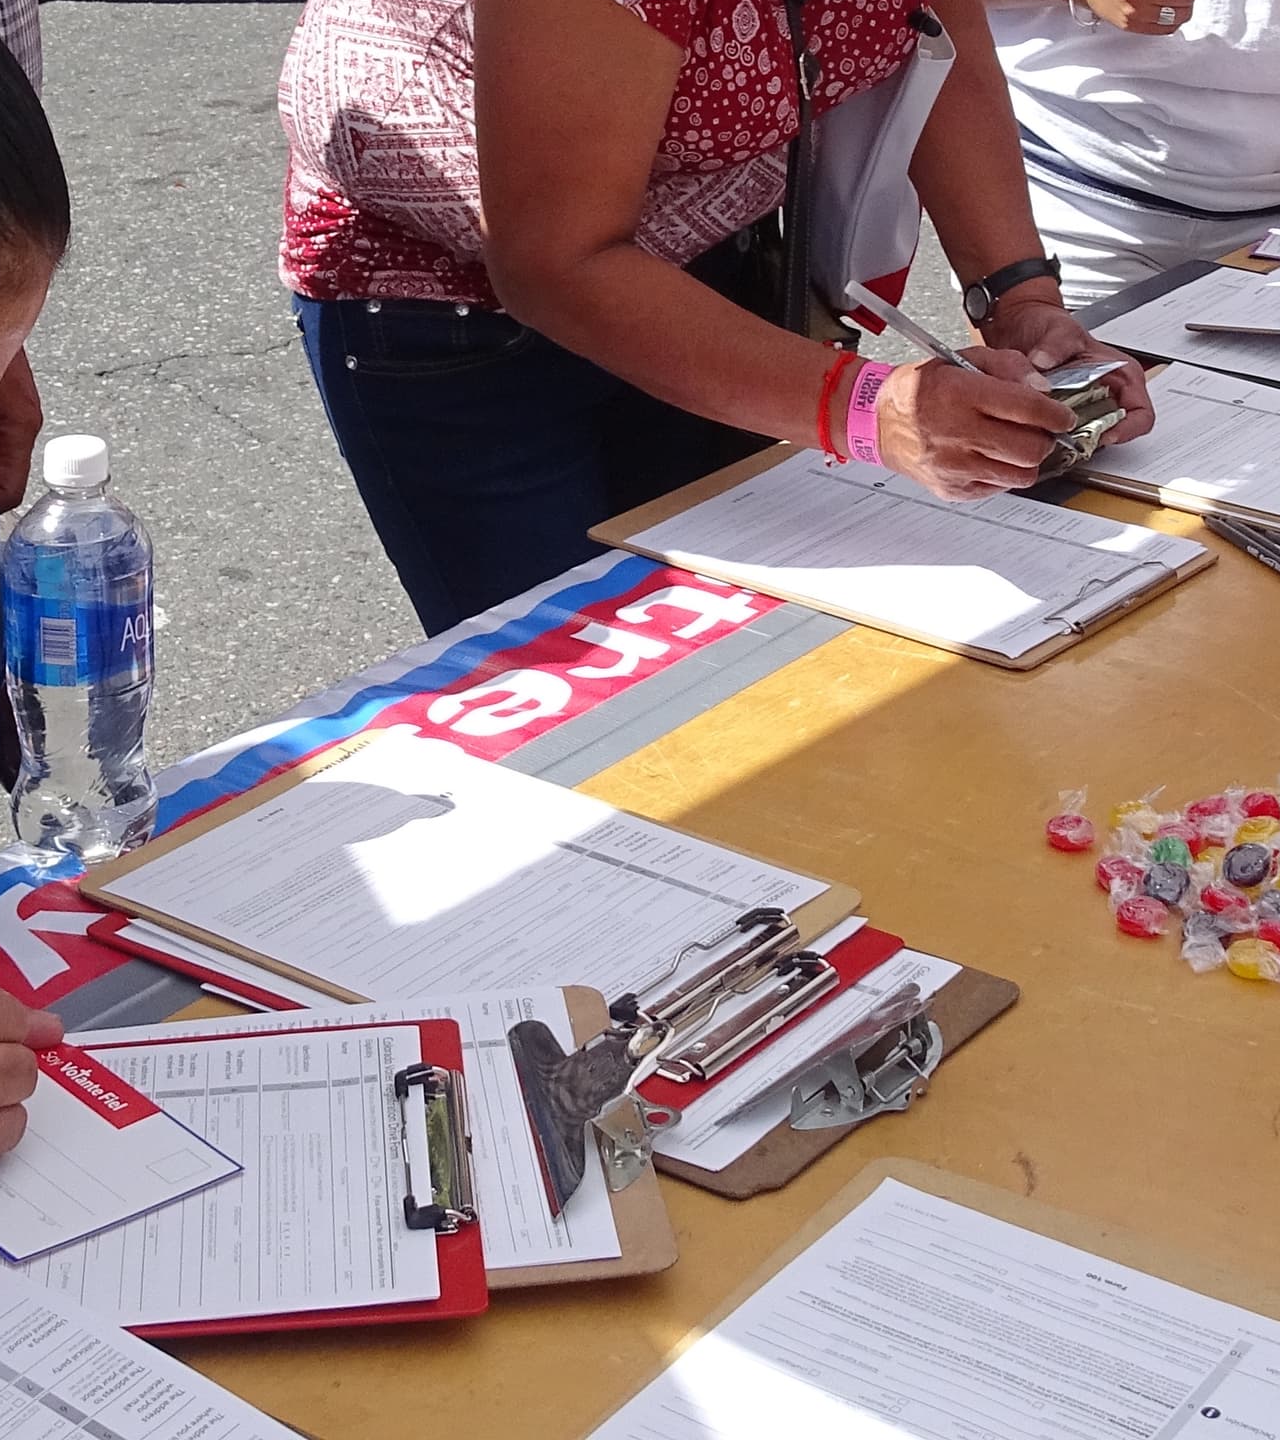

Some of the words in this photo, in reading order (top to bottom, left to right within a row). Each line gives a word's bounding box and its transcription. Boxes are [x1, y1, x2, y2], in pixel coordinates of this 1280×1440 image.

[522, 997, 535, 1020] Colora
[98, 1091, 128, 1111] Fiel
[69, 1335, 100, 1361] Political
[50, 1356, 72, 1376] party
